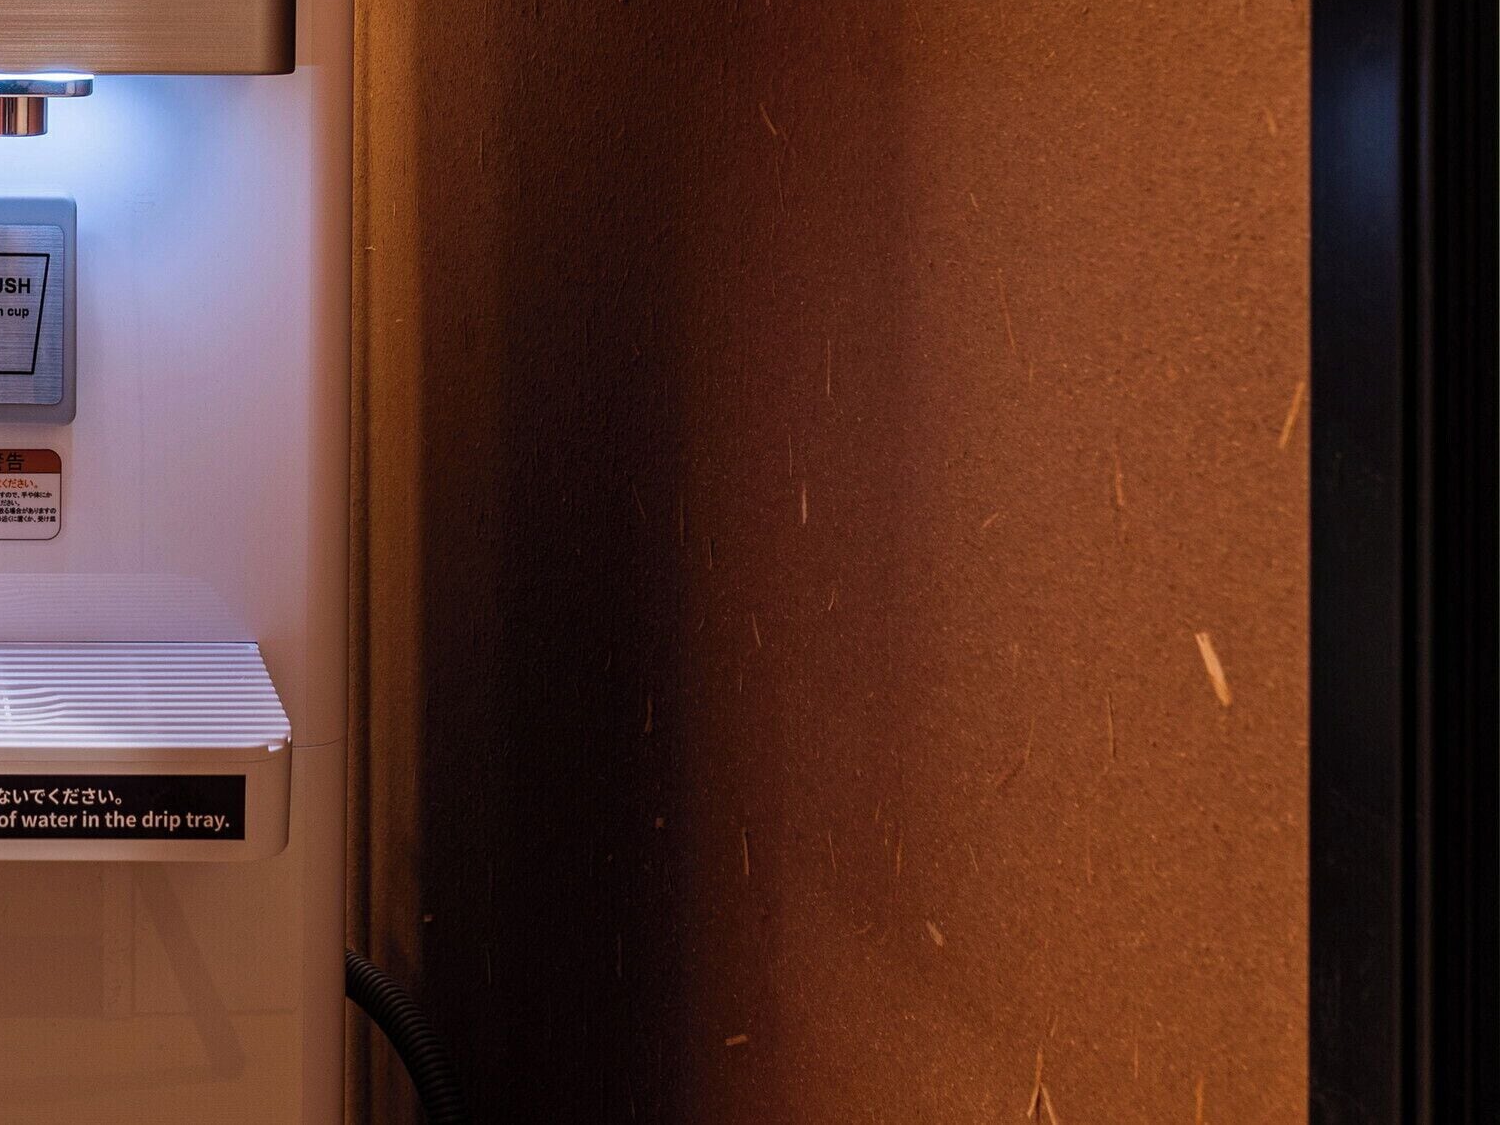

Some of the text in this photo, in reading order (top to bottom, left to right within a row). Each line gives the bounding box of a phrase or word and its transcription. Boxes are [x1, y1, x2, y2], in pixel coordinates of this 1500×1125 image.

[6, 307, 30, 319] cup
[21, 812, 78, 828] water
[82, 810, 100, 828] in
[104, 810, 136, 828] the
[141, 810, 181, 832] drip
[186, 812, 230, 832] tray.
